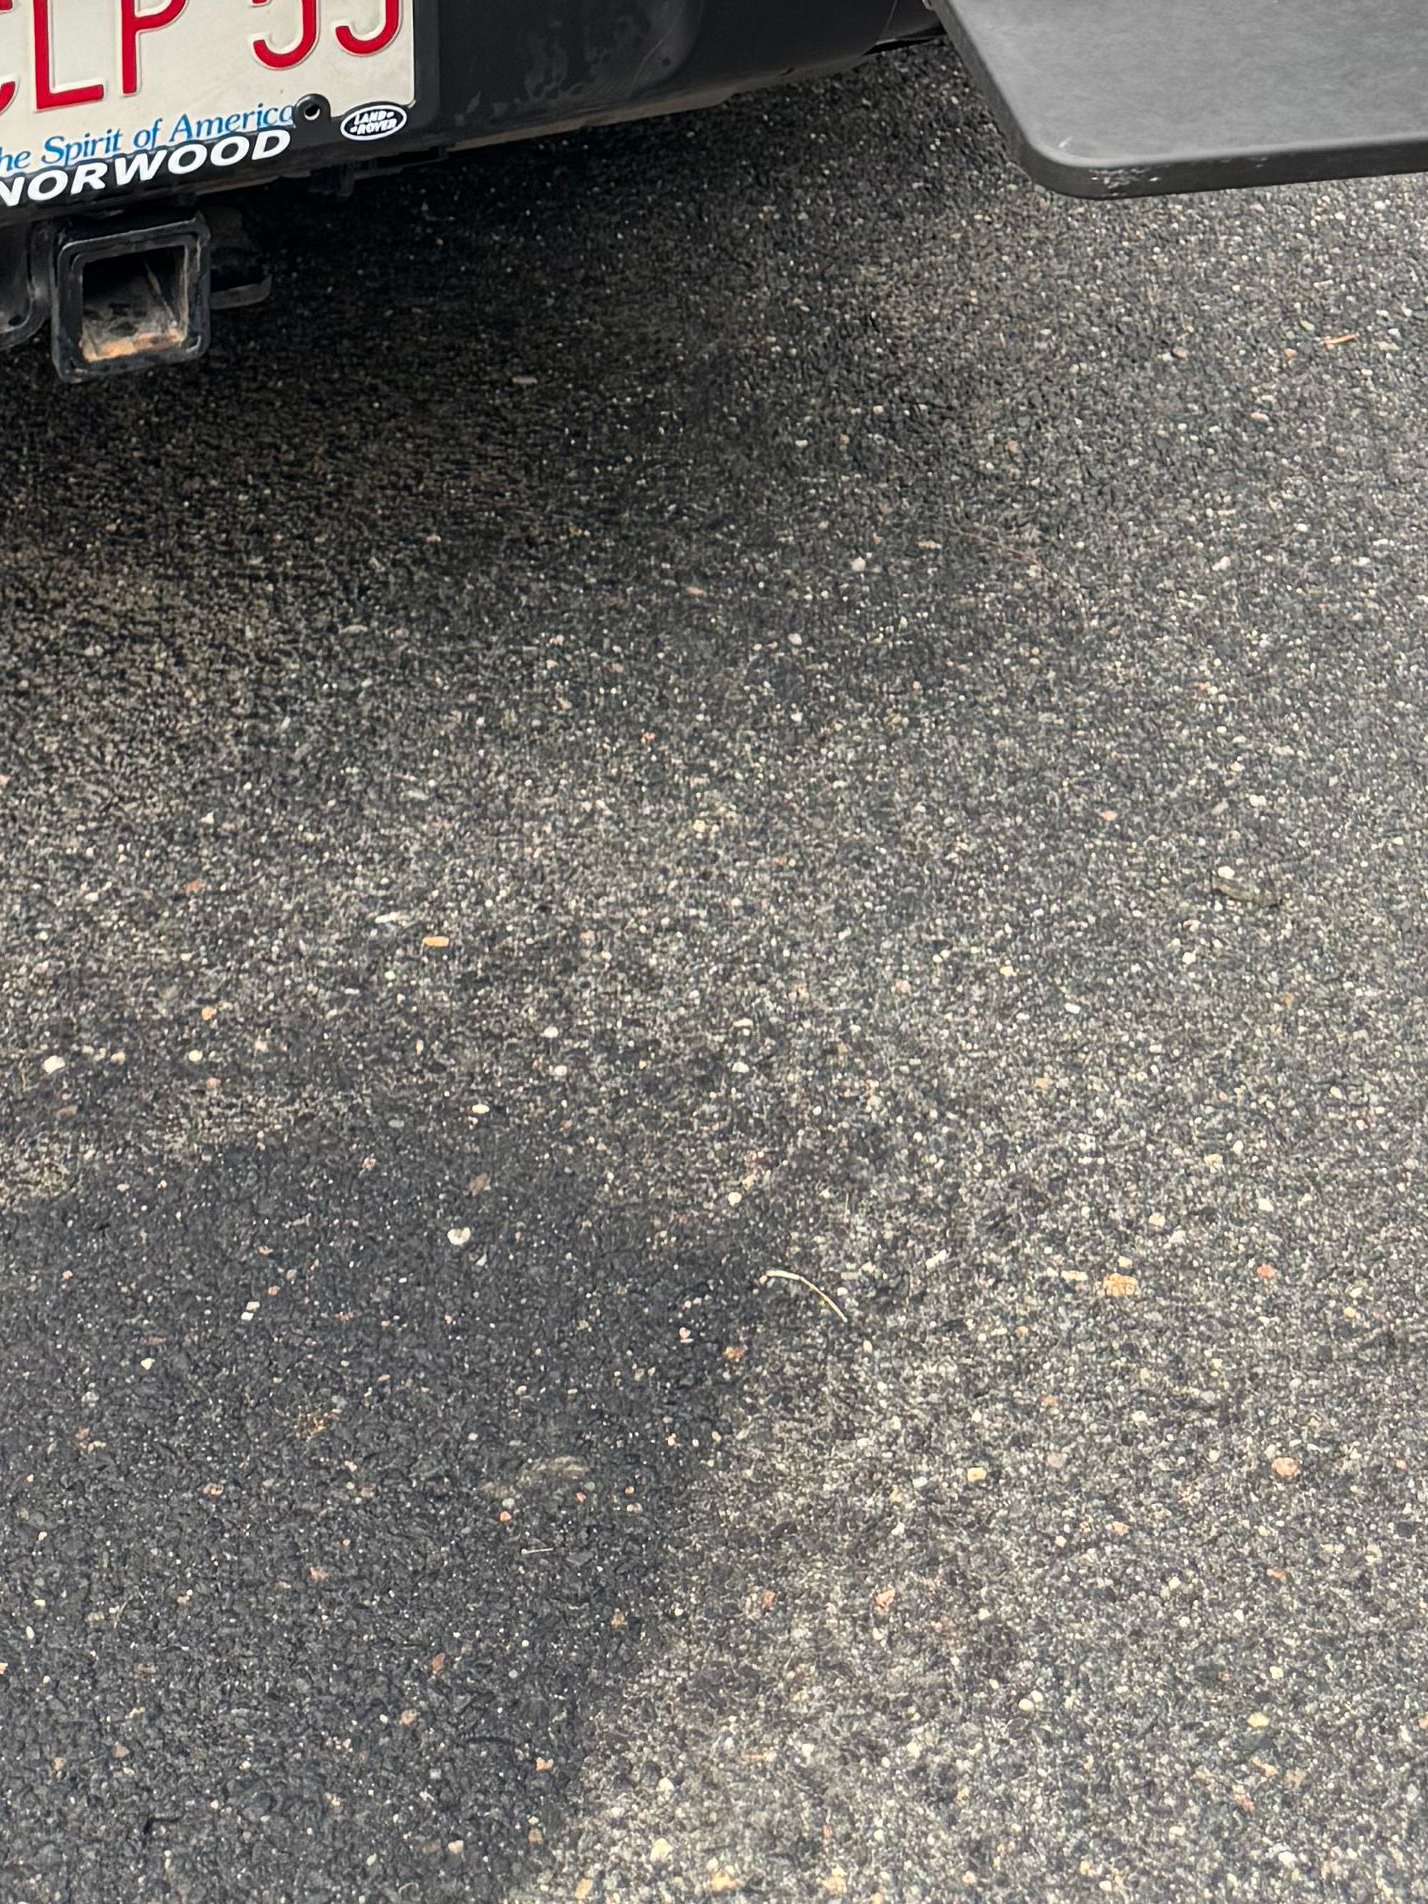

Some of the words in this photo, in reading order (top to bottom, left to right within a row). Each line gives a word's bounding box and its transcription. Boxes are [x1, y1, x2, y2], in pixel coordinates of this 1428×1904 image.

[40, 127, 124, 166] Spirit
[133, 118, 163, 150] of
[168, 102, 295, 143] America
